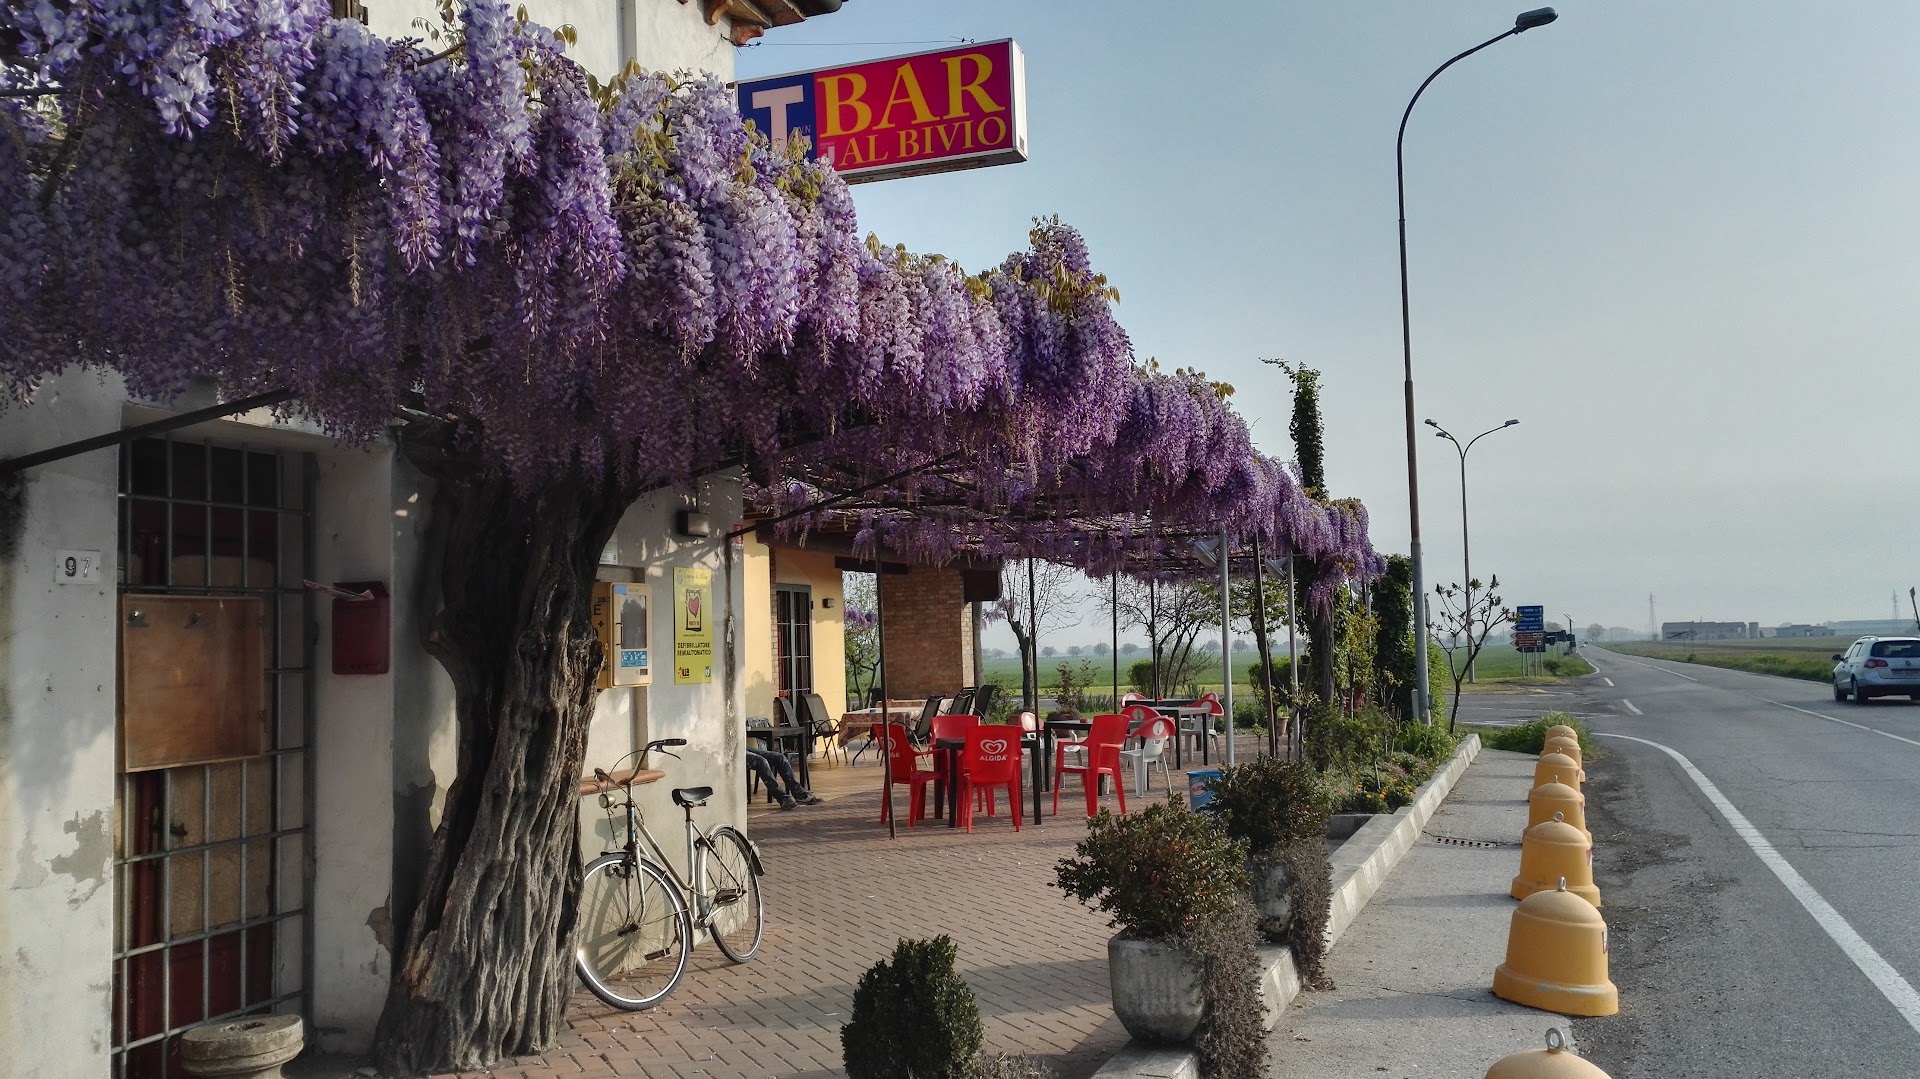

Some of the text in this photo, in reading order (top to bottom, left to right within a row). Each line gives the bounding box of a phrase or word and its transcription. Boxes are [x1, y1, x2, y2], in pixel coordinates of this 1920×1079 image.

[816, 53, 1006, 138] BAR
[839, 116, 1007, 167] AL BIVIO
[65, 556, 91, 578] 97
[979, 754, 1007, 762] ALGIDA
